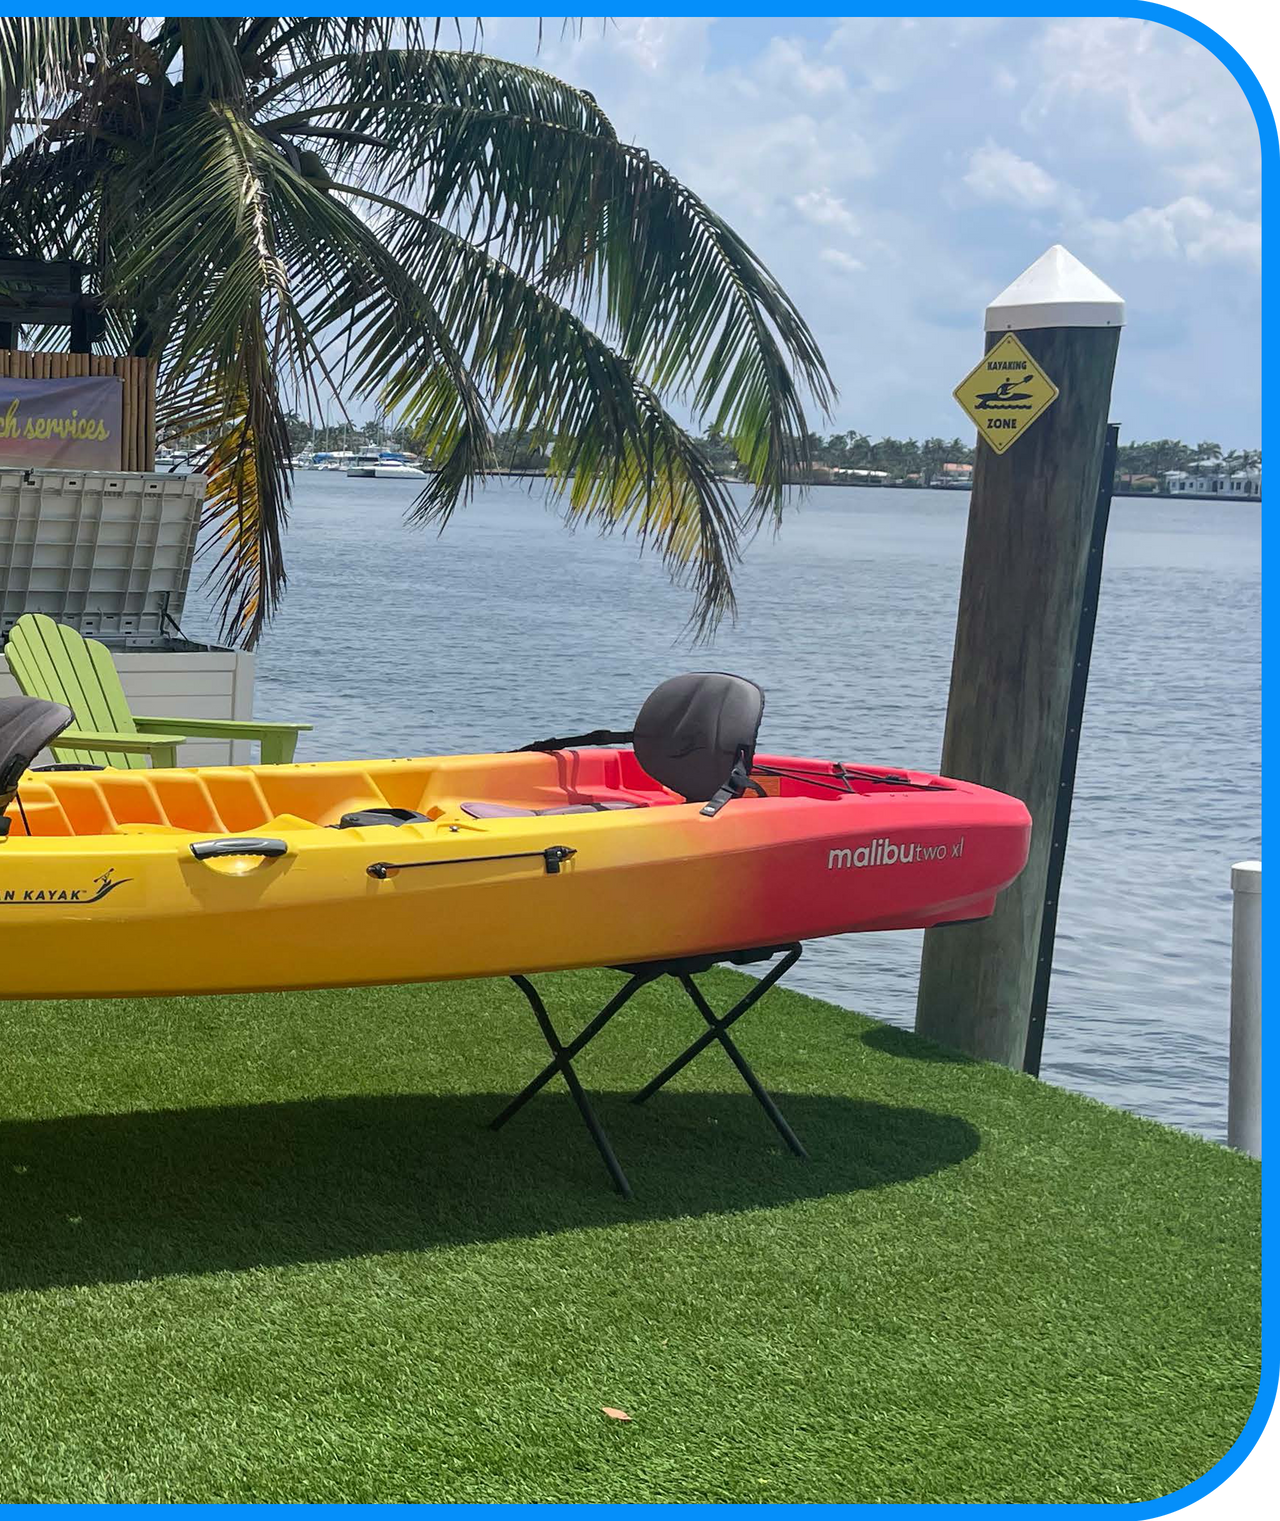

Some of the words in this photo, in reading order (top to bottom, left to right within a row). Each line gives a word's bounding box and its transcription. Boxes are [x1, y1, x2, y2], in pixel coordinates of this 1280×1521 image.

[986, 360, 1027, 371] KAYAKING
[23, 410, 109, 441] services
[986, 418, 1018, 429] ZONE
[23, 889, 81, 901] KAYAK
